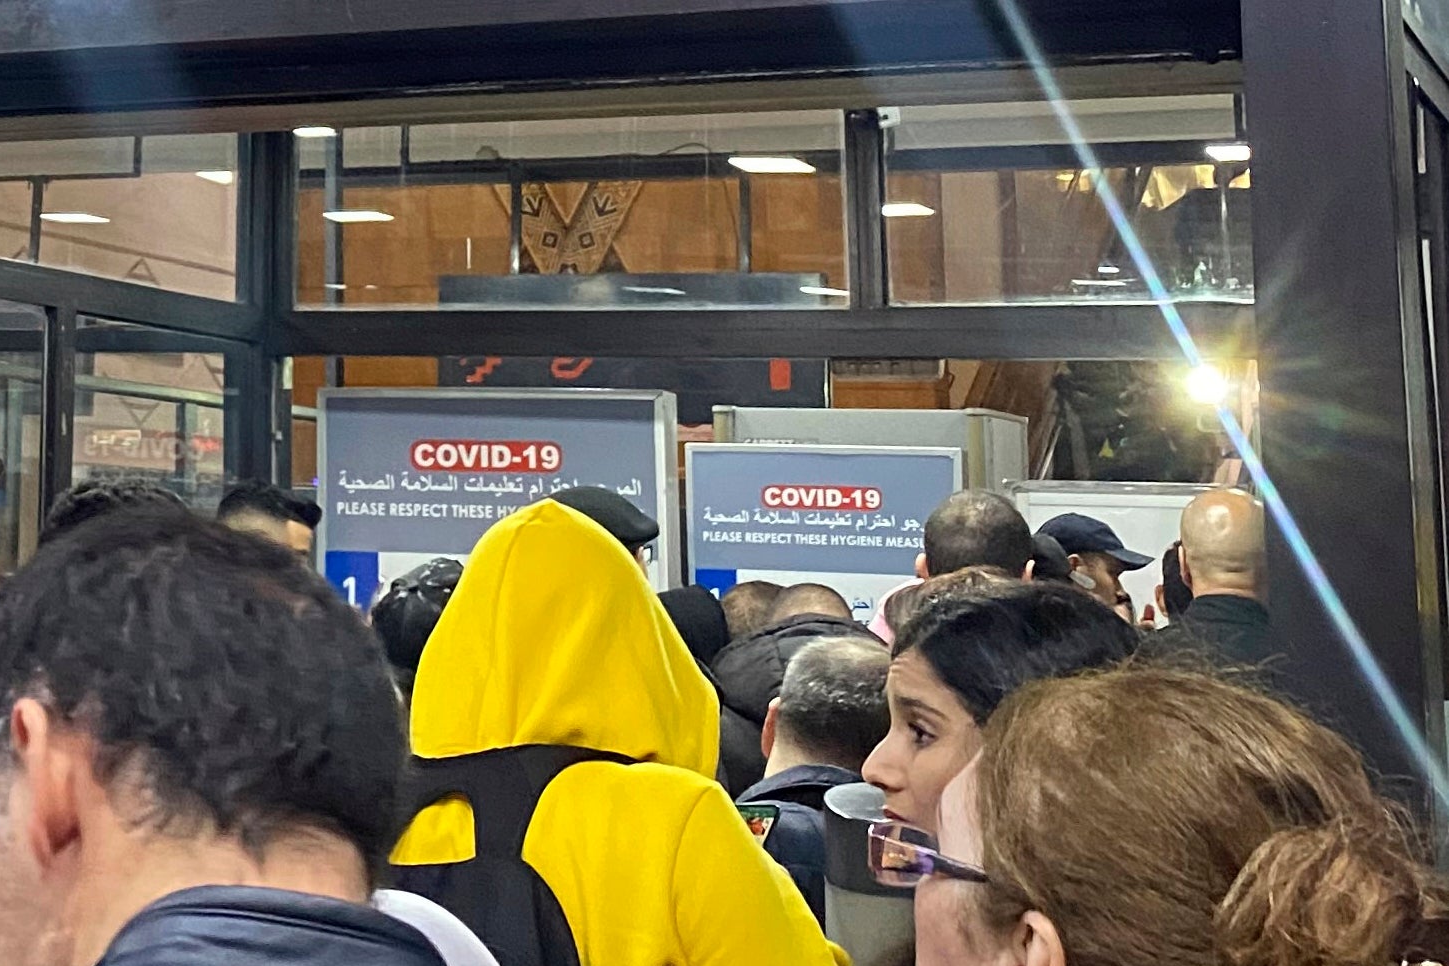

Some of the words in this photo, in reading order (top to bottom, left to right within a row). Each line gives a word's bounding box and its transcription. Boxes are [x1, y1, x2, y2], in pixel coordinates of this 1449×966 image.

[413, 443, 560, 469] COVID-19
[338, 470, 395, 493] الصحية
[401, 471, 458, 494] السلامة
[464, 474, 523, 495] تعليمات
[764, 487, 881, 508] COVID-19
[337, 501, 386, 516] PLEASE
[389, 502, 448, 518] RESPECT
[452, 504, 494, 519] THESE
[703, 506, 750, 525] الصحية
[753, 507, 800, 526] السلامة
[804, 511, 853, 530] تعليمات
[856, 513, 896, 531] احترام
[703, 530, 743, 543] PLEASE
[745, 531, 793, 545] RESPECT
[795, 532, 828, 546] THESE
[831, 534, 883, 548] HYGIENE
[342, 576, 362, 608] 1
